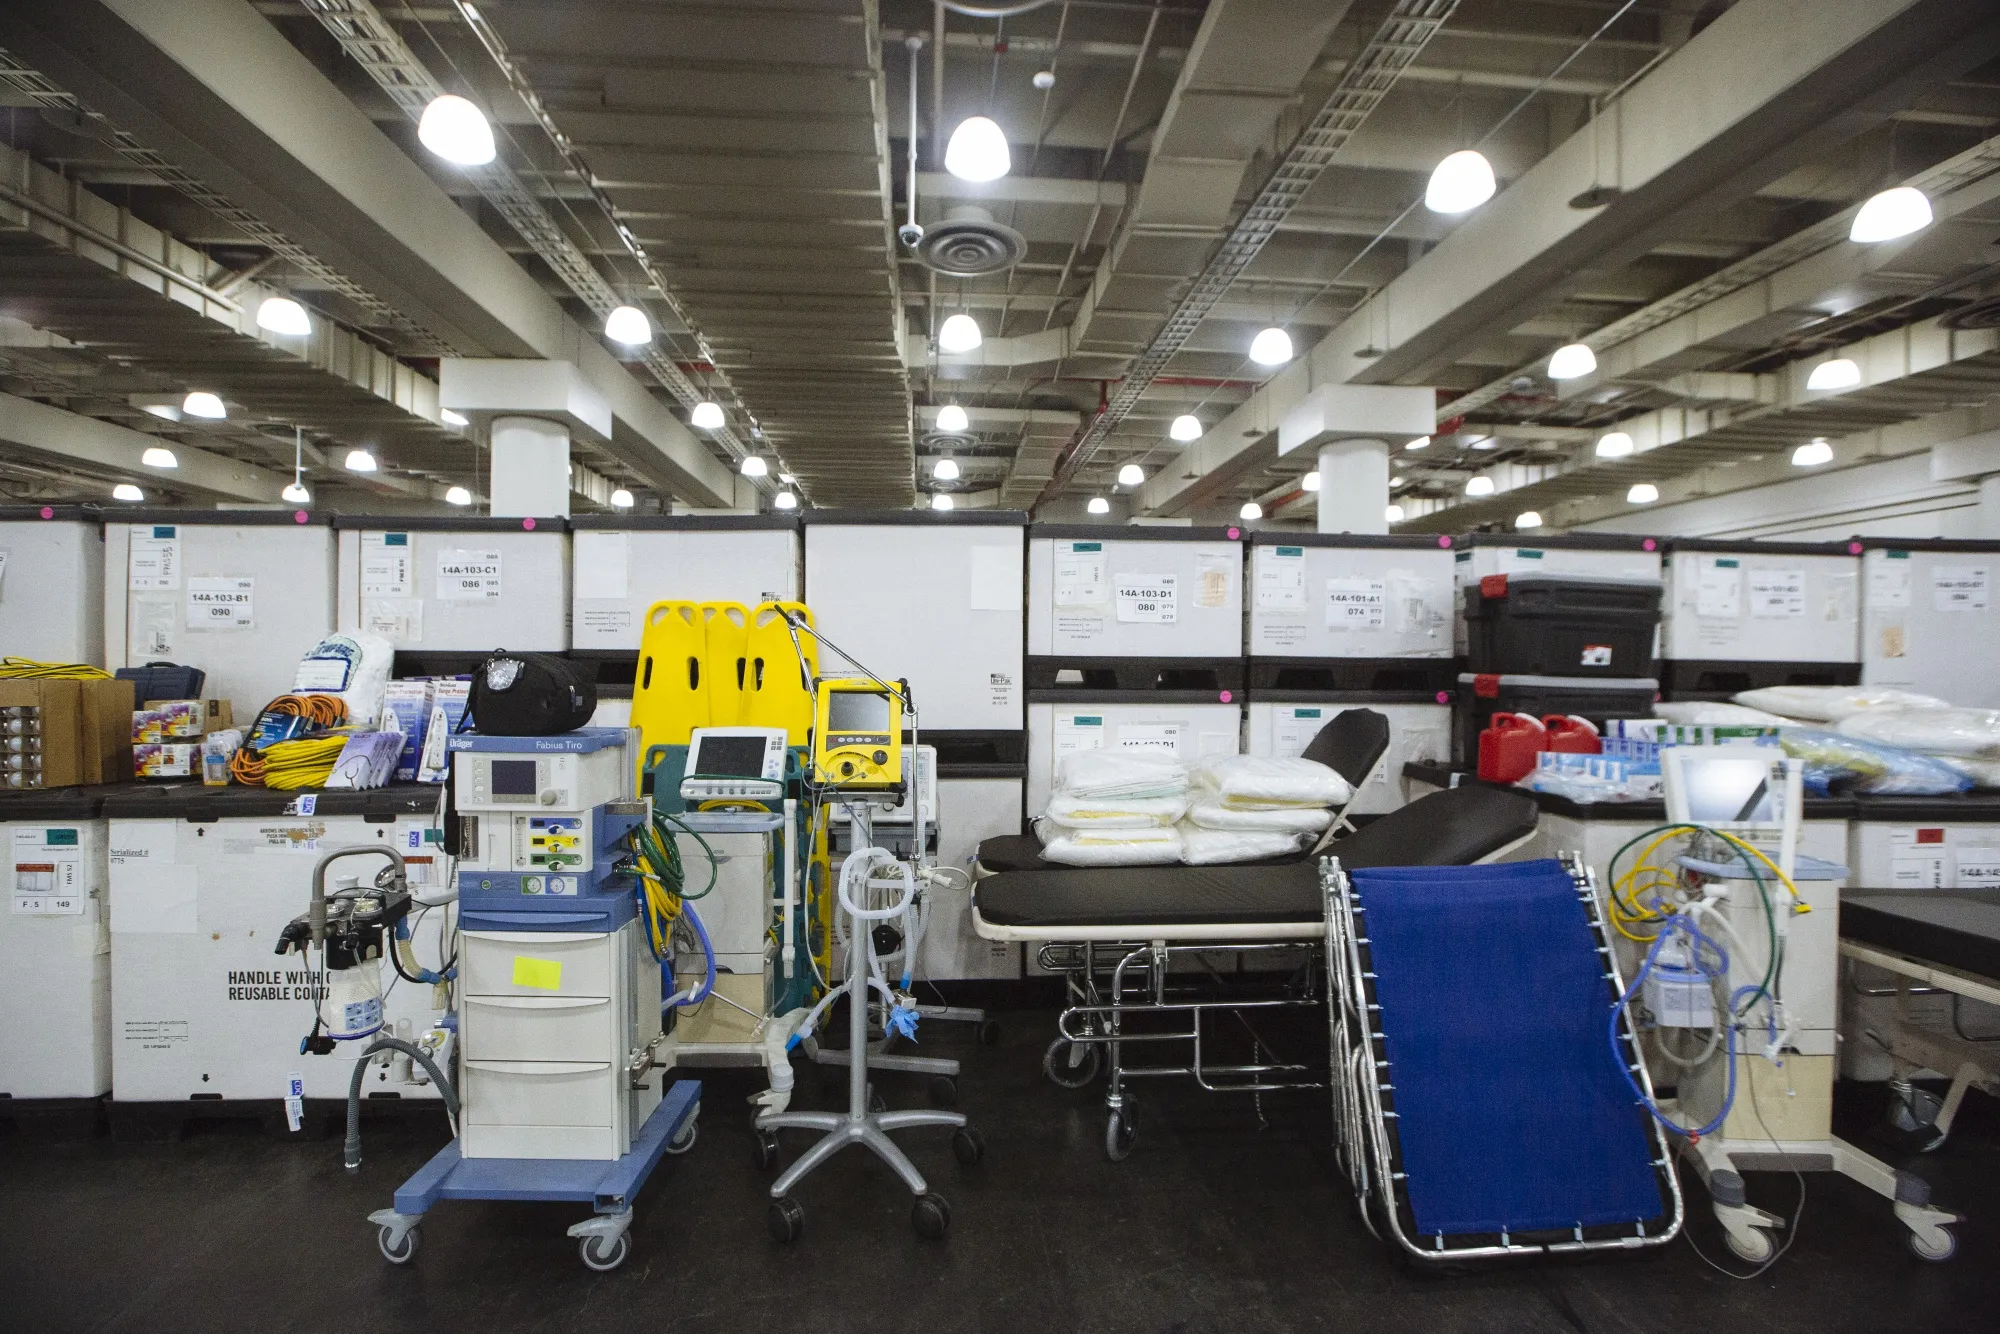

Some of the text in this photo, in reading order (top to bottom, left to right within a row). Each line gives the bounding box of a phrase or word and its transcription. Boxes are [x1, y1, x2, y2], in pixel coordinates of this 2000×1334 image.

[442, 566, 497, 574] 14A-103-C1
[462, 580, 480, 588] 086
[192, 593, 249, 602] 14A-103-B1
[1119, 589, 1173, 598] 14A-103-D1
[1330, 594, 1381, 603] 14A-101-A1
[1138, 603, 1156, 611] 080
[1348, 607, 1365, 616] 074
[211, 608, 231, 616] 090
[536, 741, 583, 749] Fabius Tiro
[229, 971, 281, 984] HANDLE
[286, 971, 320, 984] WITH
[229, 987, 290, 1000] REUSABLE
